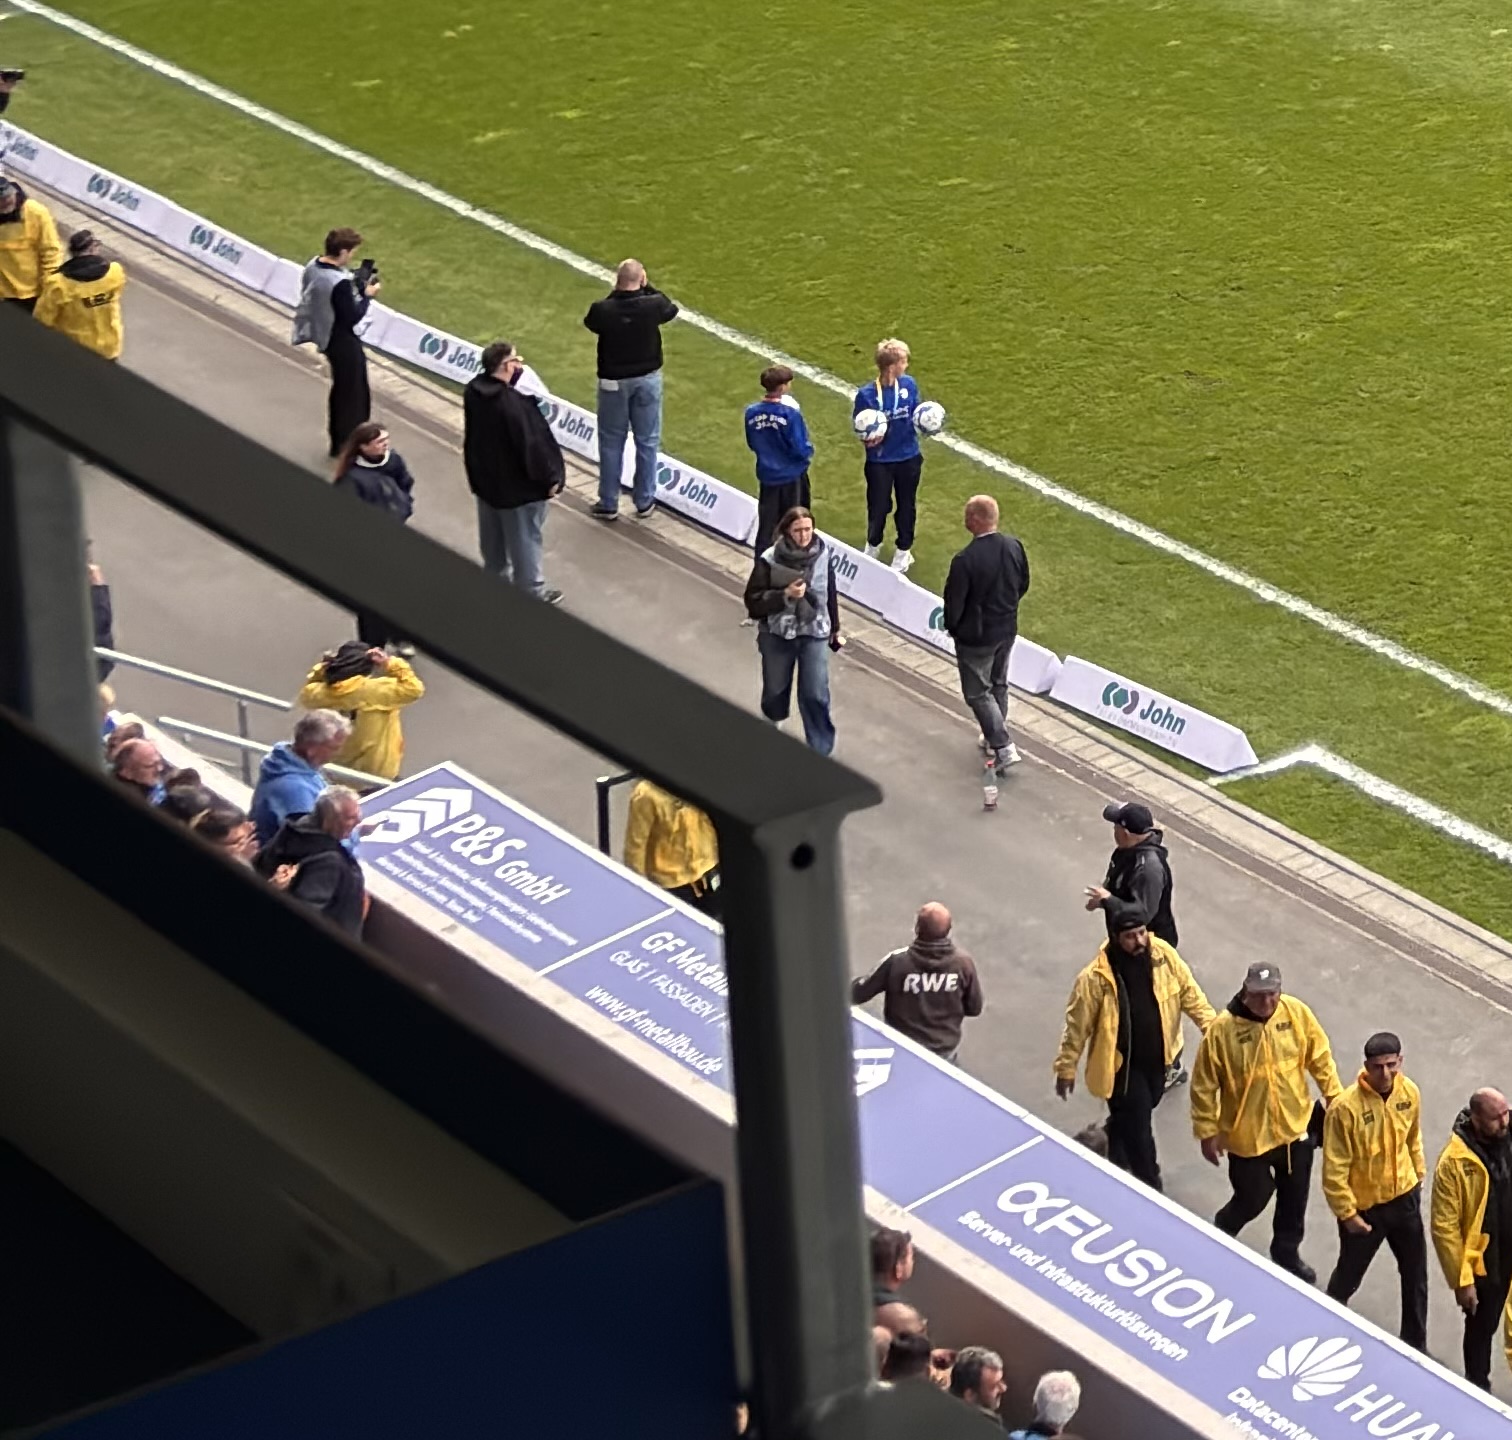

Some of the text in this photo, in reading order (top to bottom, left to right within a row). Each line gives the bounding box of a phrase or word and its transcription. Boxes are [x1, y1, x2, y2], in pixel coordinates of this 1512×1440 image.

[557, 405, 594, 440] John
[678, 477, 718, 512] John
[1139, 700, 1187, 737] John
[431, 814, 527, 867] P&S
[495, 860, 573, 906] GmbH
[902, 972, 959, 997] RWE
[584, 985, 725, 1076] www.gf-metallbau.de
